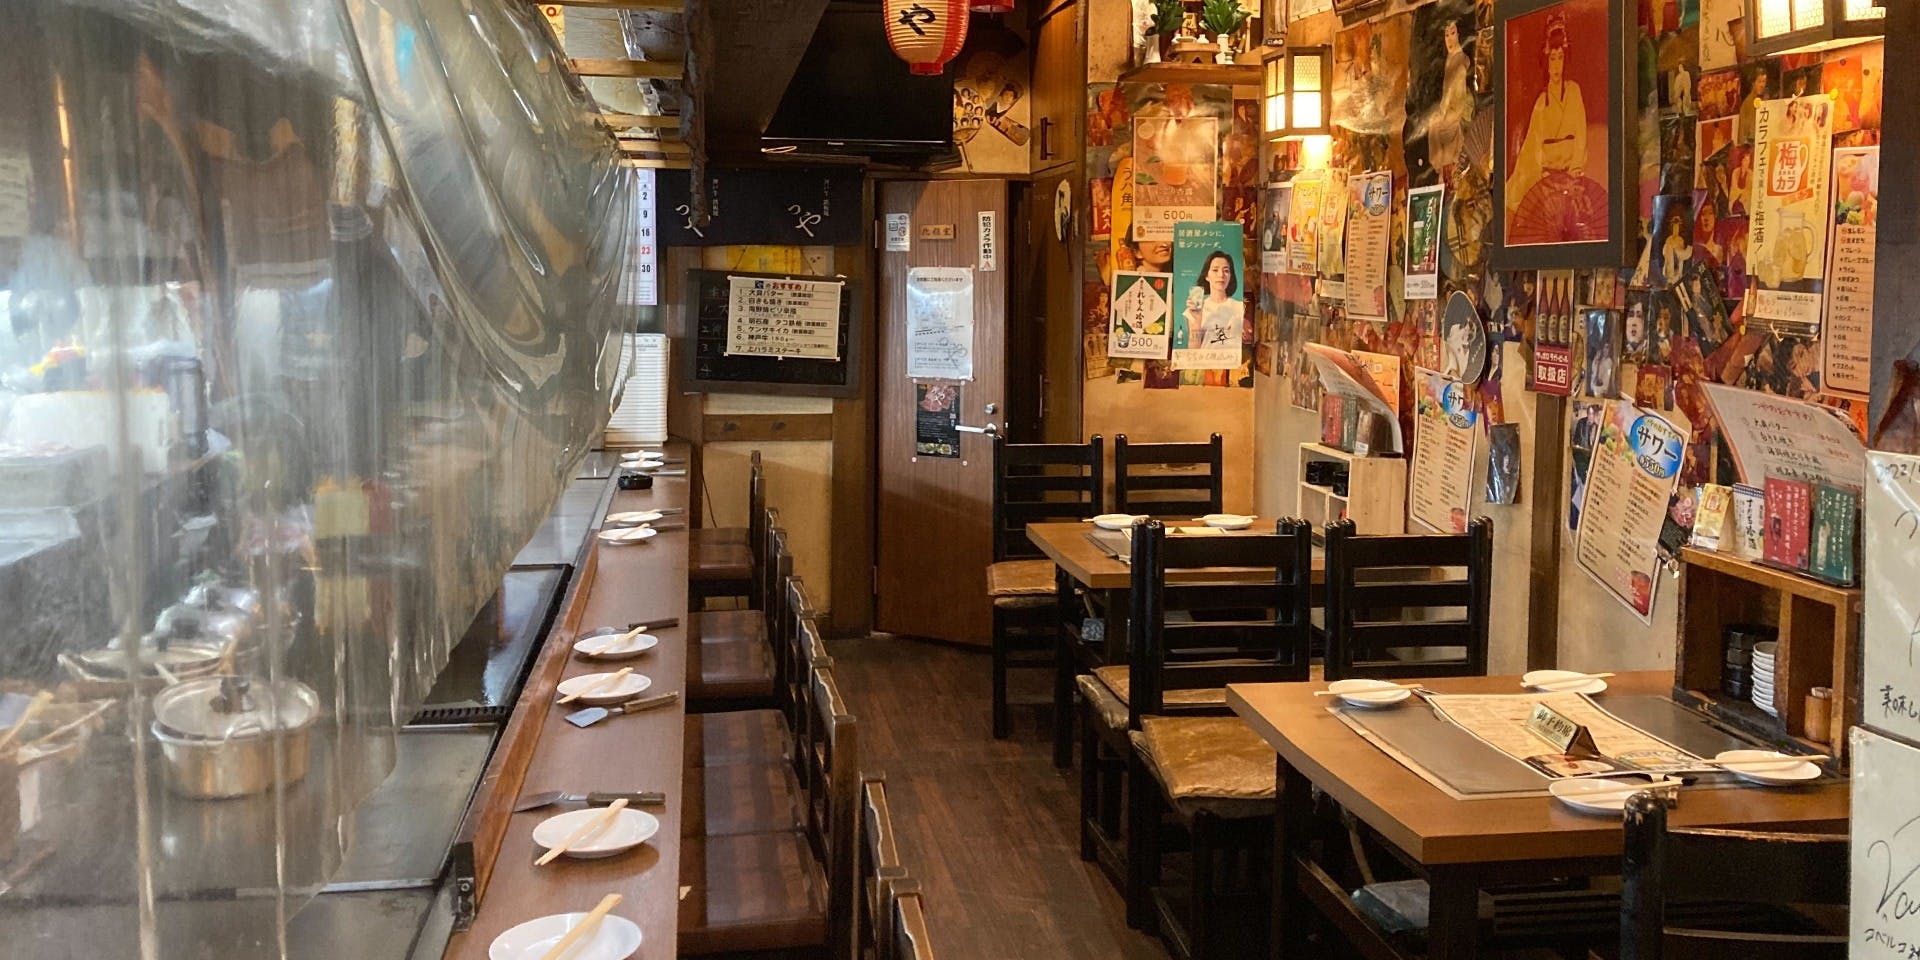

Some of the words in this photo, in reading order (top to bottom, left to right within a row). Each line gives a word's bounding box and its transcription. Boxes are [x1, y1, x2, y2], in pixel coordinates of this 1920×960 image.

[898, 3, 936, 36] や
[1779, 143, 1798, 169] 梅
[1776, 176, 1796, 190] カラ
[642, 192, 648, 200] 2
[1368, 189, 1388, 204] サワー
[642, 210, 648, 219] 9
[787, 204, 821, 237] つや
[1164, 210, 1192, 220] 600円
[641, 228, 650, 237] 16
[982, 216, 992, 259] 防犯カメラ作動中
[641, 246, 650, 254] 23
[641, 265, 651, 273] 30
[1537, 365, 1567, 384] 取扱店
[1638, 426, 1677, 459] サワー
